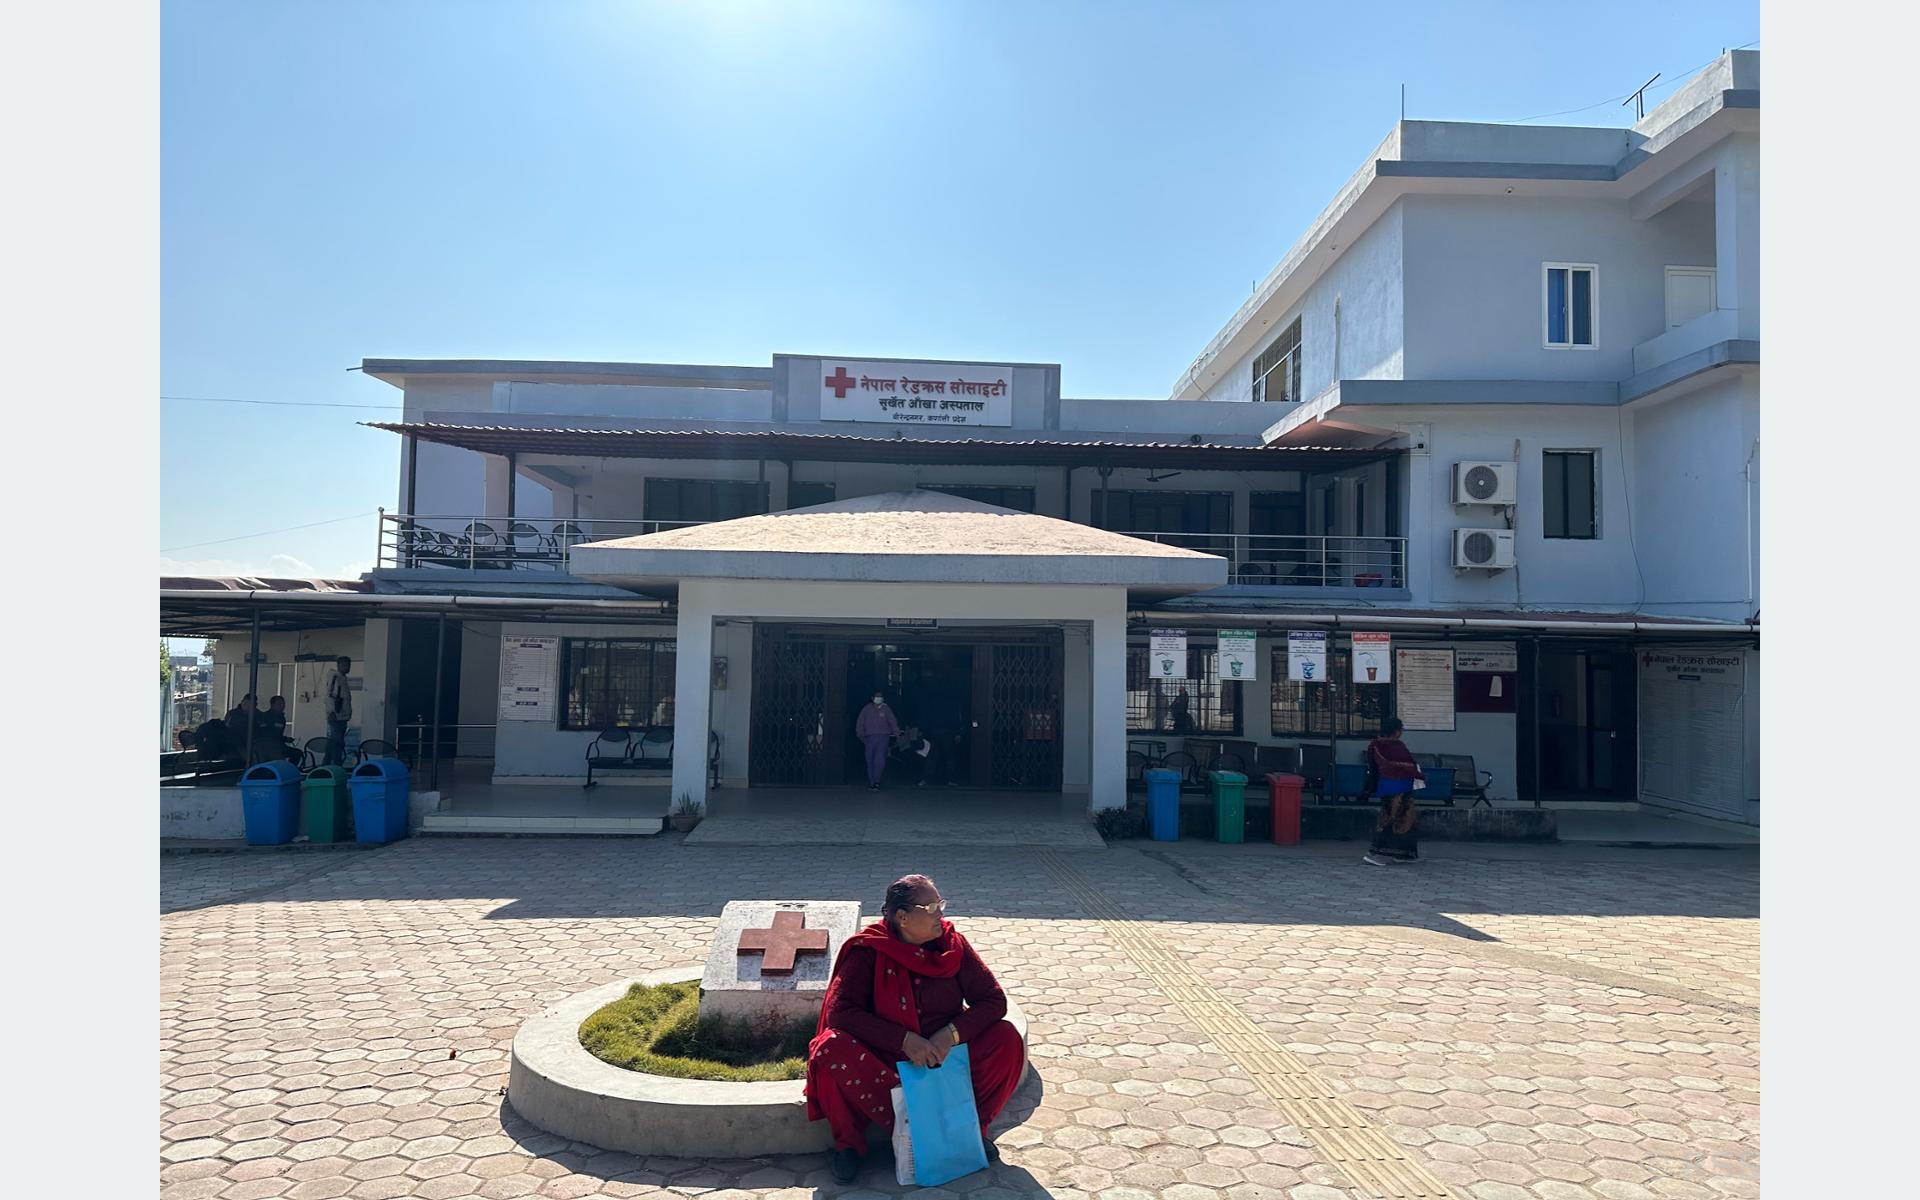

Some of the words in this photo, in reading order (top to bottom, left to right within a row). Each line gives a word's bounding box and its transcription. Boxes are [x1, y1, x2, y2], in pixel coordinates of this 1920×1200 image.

[860, 375, 896, 392] नेपाल
[900, 376, 946, 395] रेडक्रस
[950, 378, 1007, 398] सोसाइटी
[908, 395, 937, 410] आँखा
[939, 399, 984, 412] अस्पताल
